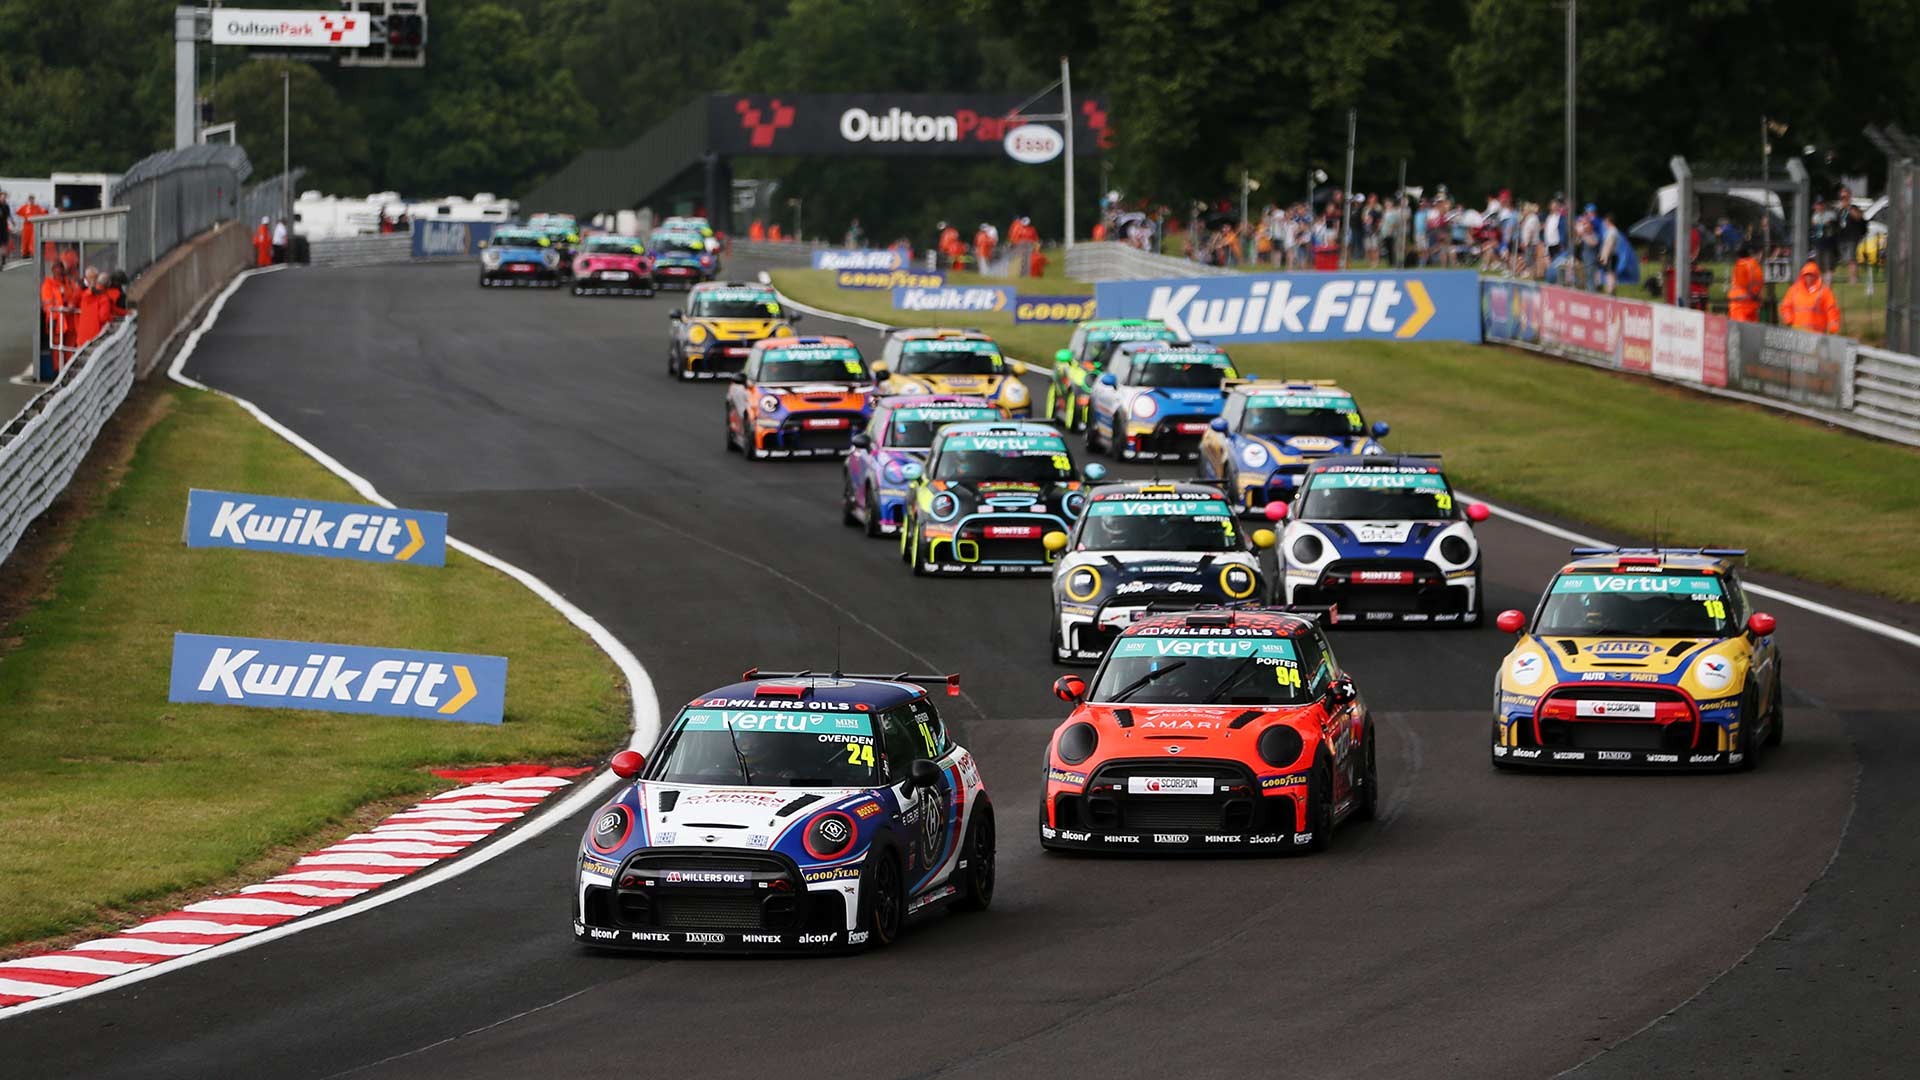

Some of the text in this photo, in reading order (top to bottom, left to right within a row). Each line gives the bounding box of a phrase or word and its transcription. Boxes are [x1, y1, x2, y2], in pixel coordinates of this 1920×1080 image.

[228, 20, 312, 36] OultonPark
[903, 288, 997, 311] KwikFit
[1147, 280, 1403, 343] KwikFit
[926, 340, 971, 352] Vertu
[1272, 396, 1326, 407] Vertu
[918, 409, 971, 421] Vertu
[973, 437, 1029, 450] Vertu
[1344, 465, 1398, 473] MILLERS
[1343, 475, 1406, 487] Vertu
[1182, 493, 1211, 501] OILS
[1122, 502, 1187, 515] Vertu
[210, 501, 403, 555] KwikFit
[1221, 521, 1236, 537] 2
[1361, 571, 1402, 580] MINTEX
[1168, 581, 1203, 593] Guys
[1592, 576, 1668, 591] Vertu
[1703, 600, 1726, 620] 18
[1160, 627, 1273, 637] MILLERS OILS
[1156, 639, 1237, 656] Vertu
[1597, 642, 1652, 655] NAPA
[1256, 658, 1298, 669] PORTER
[198, 647, 448, 707] KwikFit
[1275, 666, 1302, 689] 94
[1582, 672, 1659, 682] AUTO PARTS
[727, 699, 850, 711] MILLERS OILS
[1606, 702, 1641, 713] SCORPION
[1700, 700, 1739, 711] GOODYEAR
[721, 711, 808, 731] Vertu
[1140, 720, 1220, 730] AMARI
[818, 734, 874, 745] OVENDEN
[846, 742, 875, 768] 24
[1160, 778, 1198, 789] SCORPION
[1261, 775, 1307, 788] GOODYEAR
[687, 794, 786, 803] OVENDEN
[1062, 831, 1085, 842] alcon
[1104, 835, 1140, 843] MINTEX
[1153, 834, 1189, 843] DAMICO
[1205, 835, 1241, 843] MINTEX
[1250, 835, 1277, 843] alcon
[682, 873, 745, 883] MILLERS OILS
[806, 867, 860, 881] GOODYEAR
[591, 929, 613, 940] alcon
[632, 933, 670, 942] MINTEX
[686, 933, 725, 943] DAMICO
[742, 934, 782, 943] MINTEX
[799, 933, 828, 944] alcon
